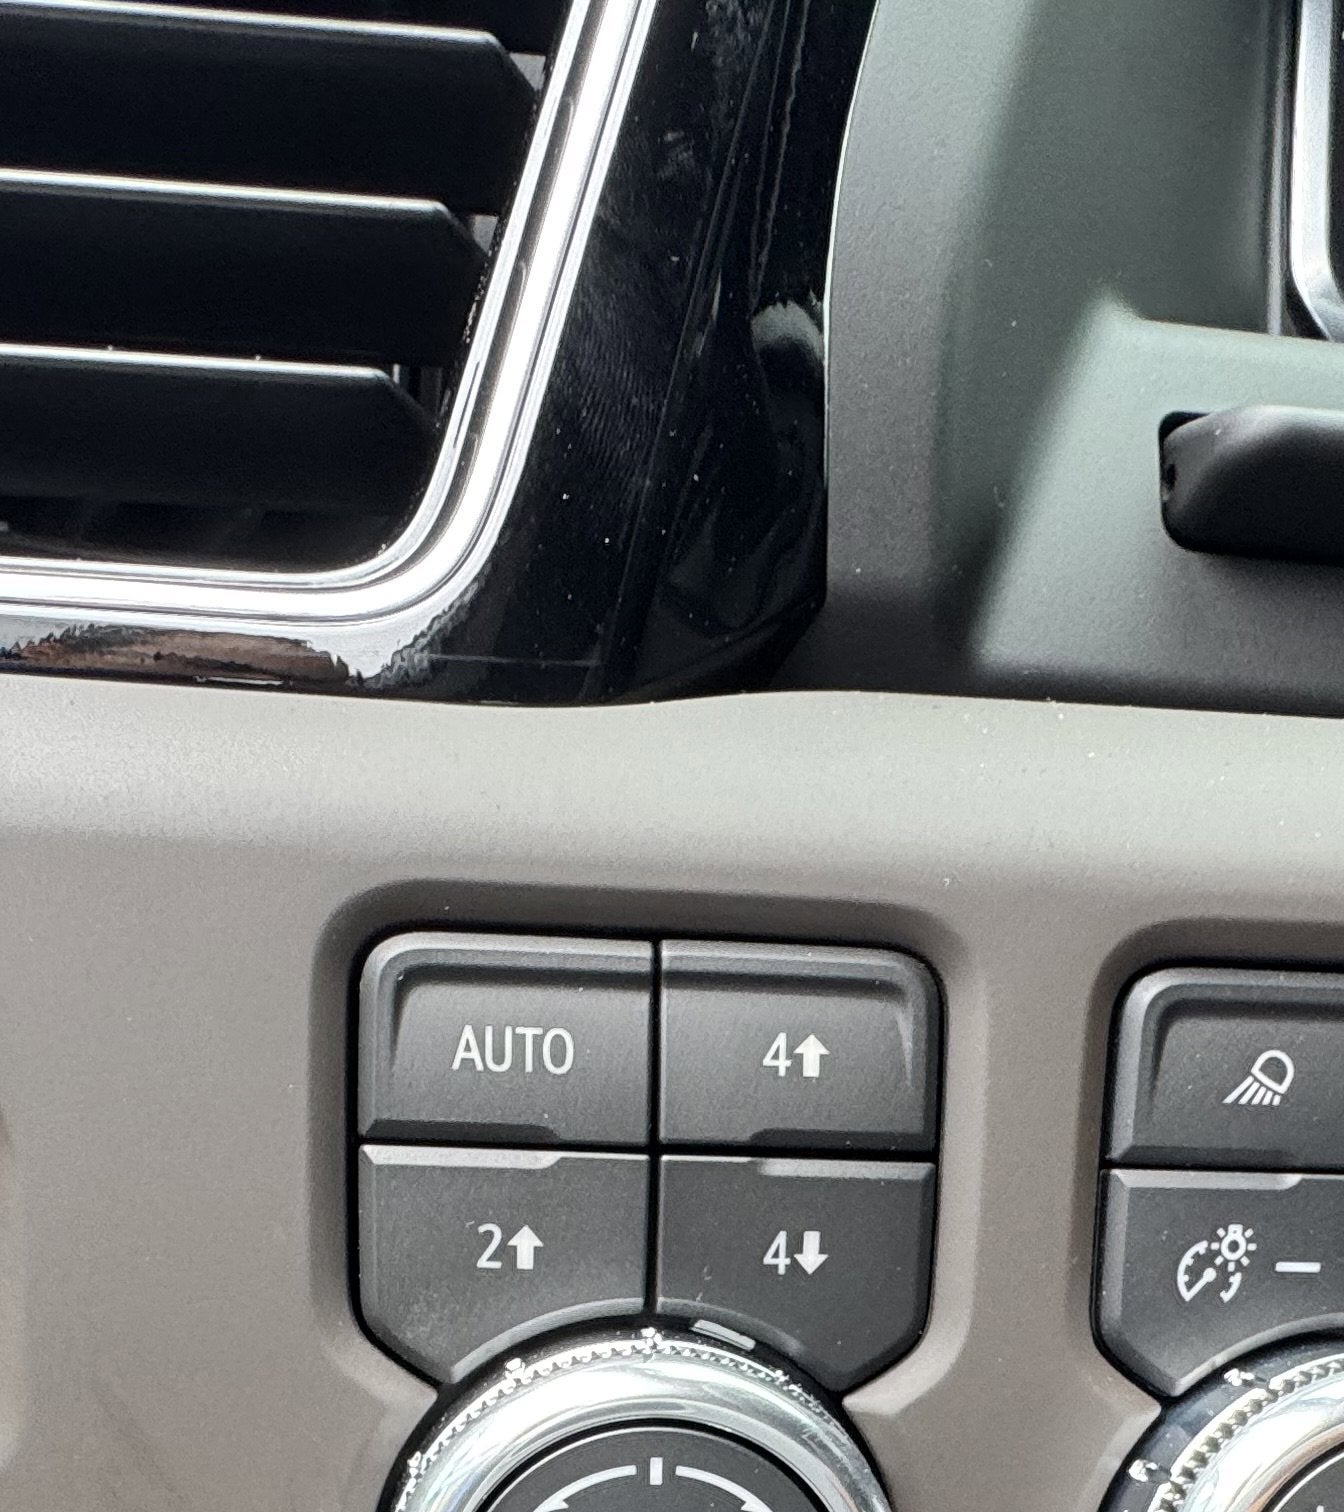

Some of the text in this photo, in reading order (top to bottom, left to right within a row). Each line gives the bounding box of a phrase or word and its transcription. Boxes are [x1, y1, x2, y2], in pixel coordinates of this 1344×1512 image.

[451, 1024, 575, 1075] AUTO
[762, 1031, 792, 1077] 4
[476, 1223, 503, 1270] 2
[762, 1230, 791, 1275] 4
